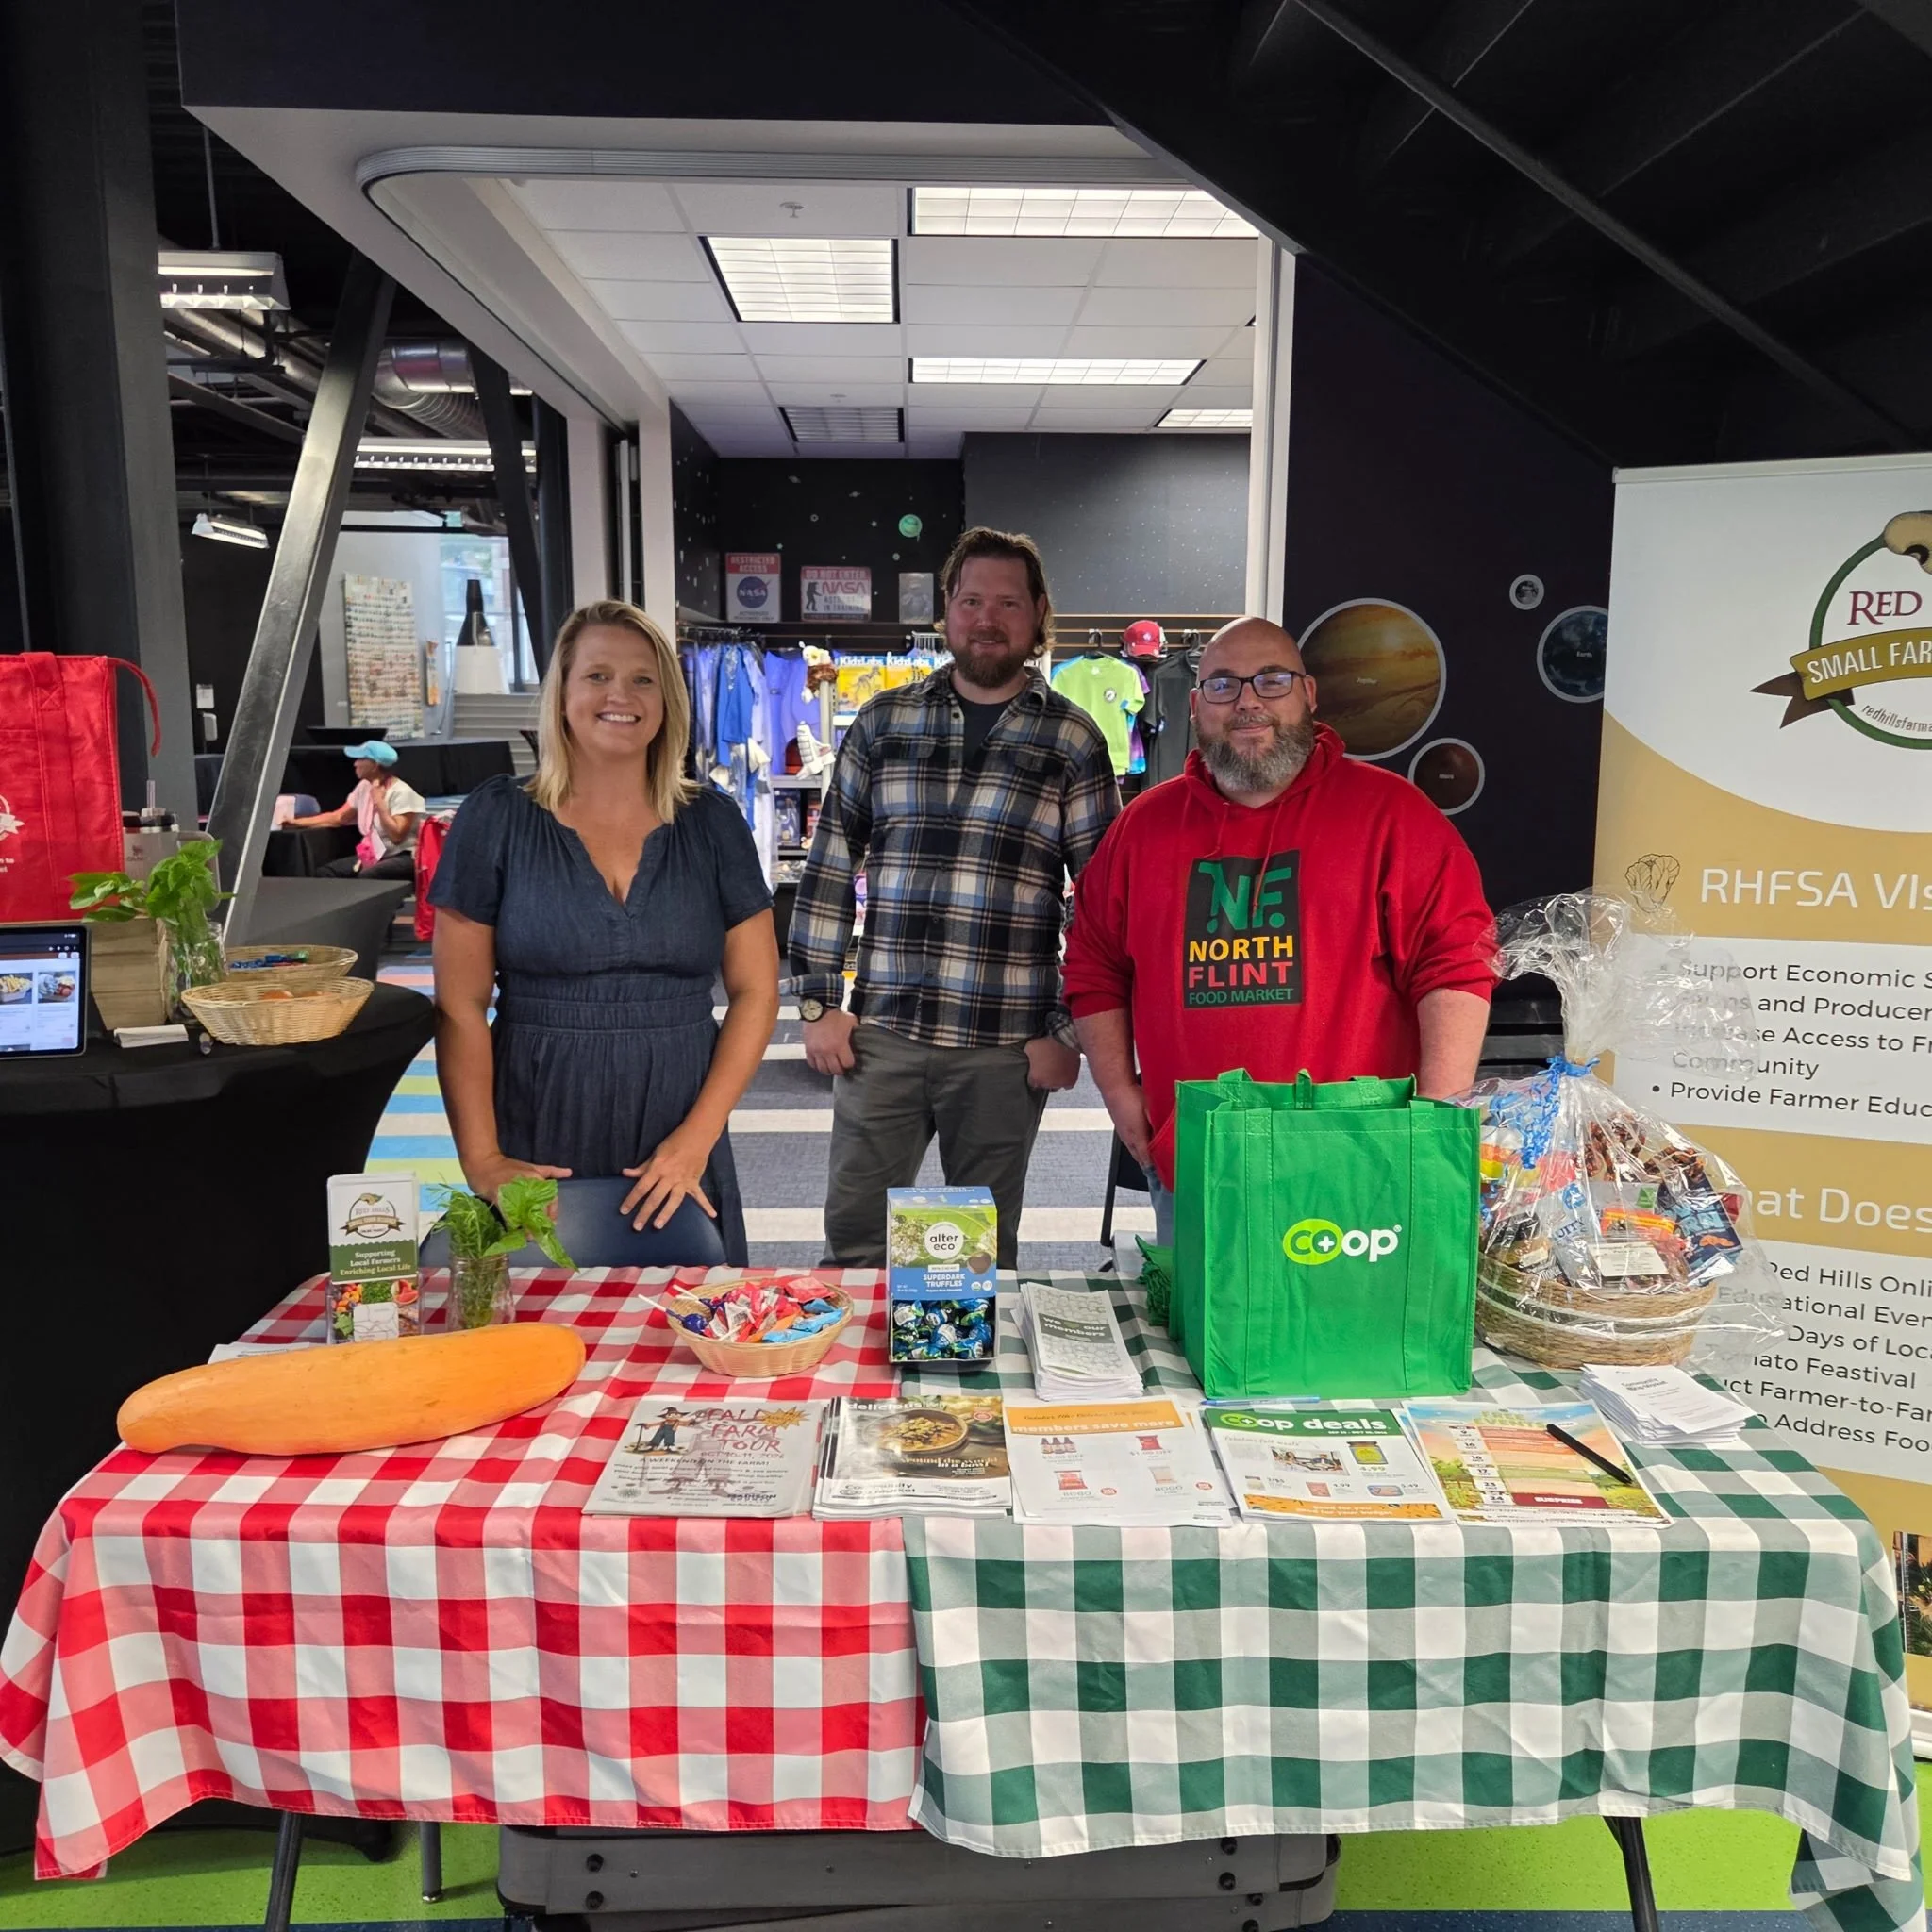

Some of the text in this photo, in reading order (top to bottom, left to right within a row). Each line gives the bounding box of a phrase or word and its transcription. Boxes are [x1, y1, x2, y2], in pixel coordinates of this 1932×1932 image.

[739, 589, 767, 597] NASA
[823, 581, 868, 595] NASA
[1846, 591, 1923, 625] RED
[1807, 646, 1883, 685] SMALL
[1701, 868, 1857, 908] RHFSA
[1189, 935, 1294, 963] NORTH
[1188, 961, 1294, 989] FLINT
[1786, 964, 1916, 989] Economic
[1189, 988, 1294, 1005] FOOD MARKET
[1757, 996, 1805, 1013] and
[1782, 1027, 1869, 1049] Access
[1877, 1033, 1904, 1052] to
[1670, 1081, 1762, 1104] Provide
[1769, 1088, 1859, 1112] Farmer
[929, 1233, 959, 1243] alter
[355, 1249, 396, 1259] Supporting
[933, 1242, 956, 1251] eco
[371, 1257, 401, 1265] Farmers
[1819, 1267, 1873, 1291] Hills
[1042, 1317, 1061, 1325] we
[1044, 1323, 1106, 1337] members
[1852, 1335, 1879, 1353] of
[1807, 1357, 1916, 1390] Feastival
[708, 1407, 764, 1420] FALL
[848, 1402, 923, 1411] delicious
[711, 1423, 777, 1438] FARM
[1012, 1419, 1175, 1433] members save more
[1303, 1418, 1387, 1430] deals
[1774, 1413, 1876, 1445] Address
[718, 1439, 781, 1453] TOUR
